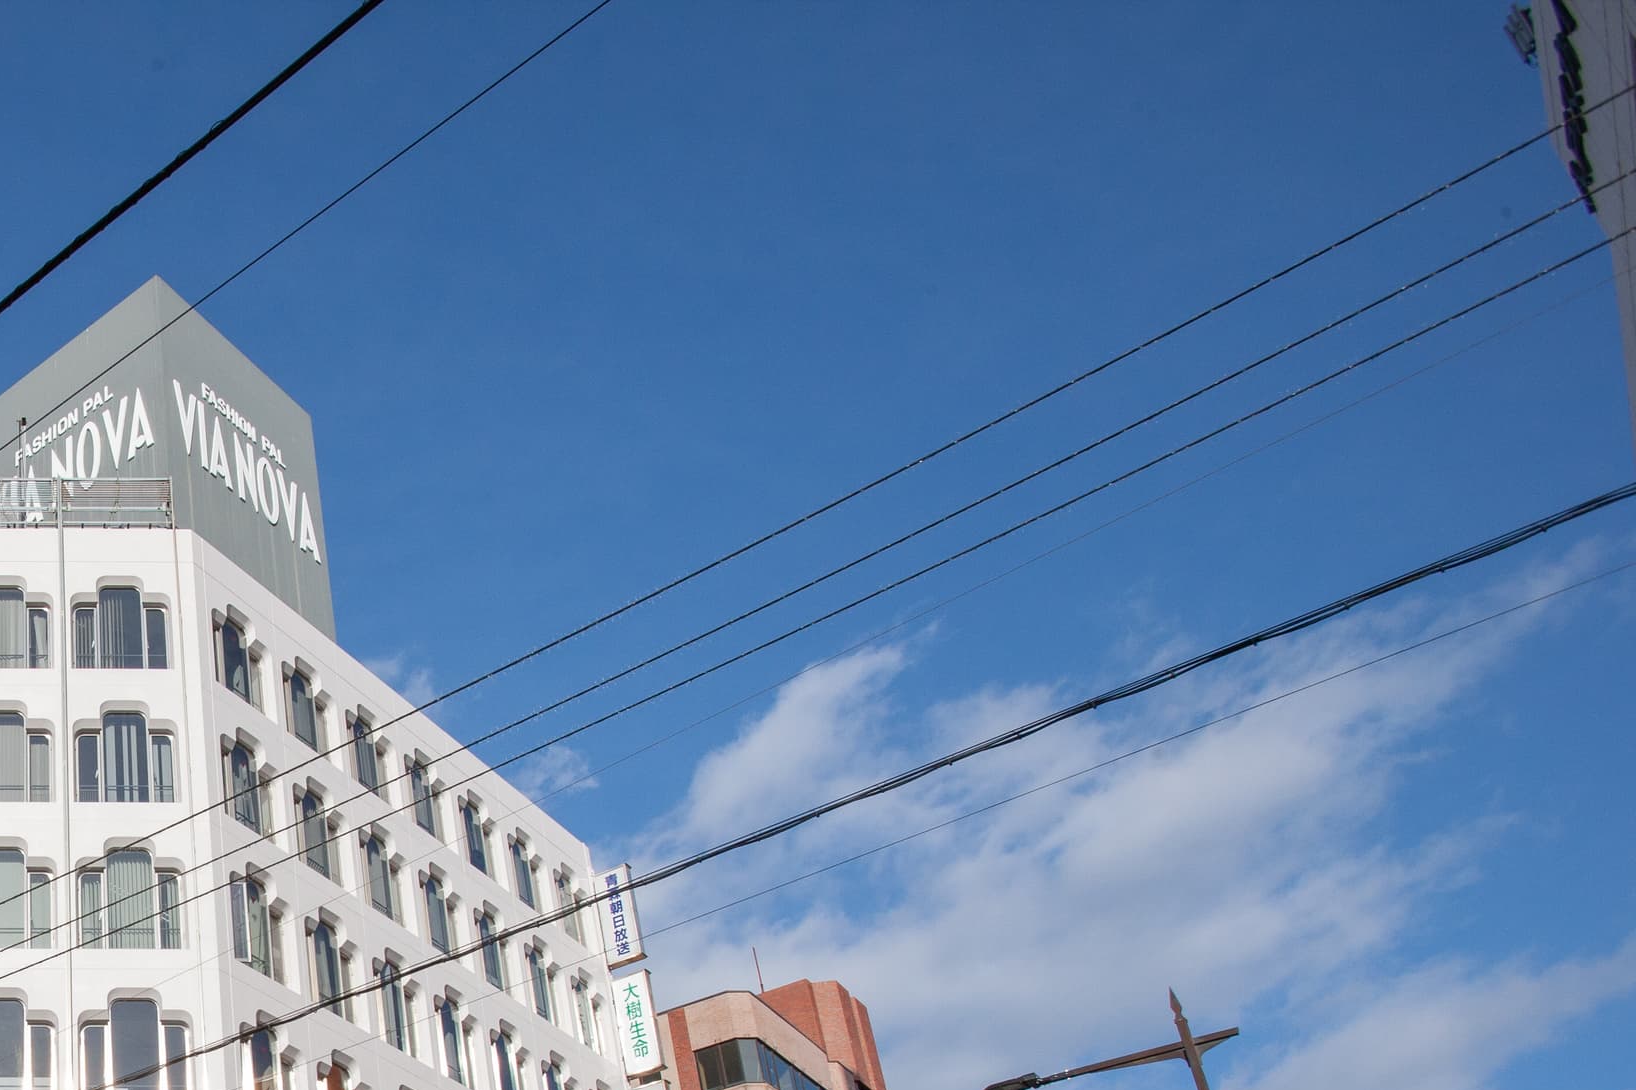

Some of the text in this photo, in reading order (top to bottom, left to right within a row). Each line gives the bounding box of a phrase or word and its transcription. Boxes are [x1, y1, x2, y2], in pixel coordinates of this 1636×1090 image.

[15, 385, 114, 467] FASHION PAL
[201, 382, 286, 470] FASHION PAL
[623, 982, 649, 1058] 大樹生命
